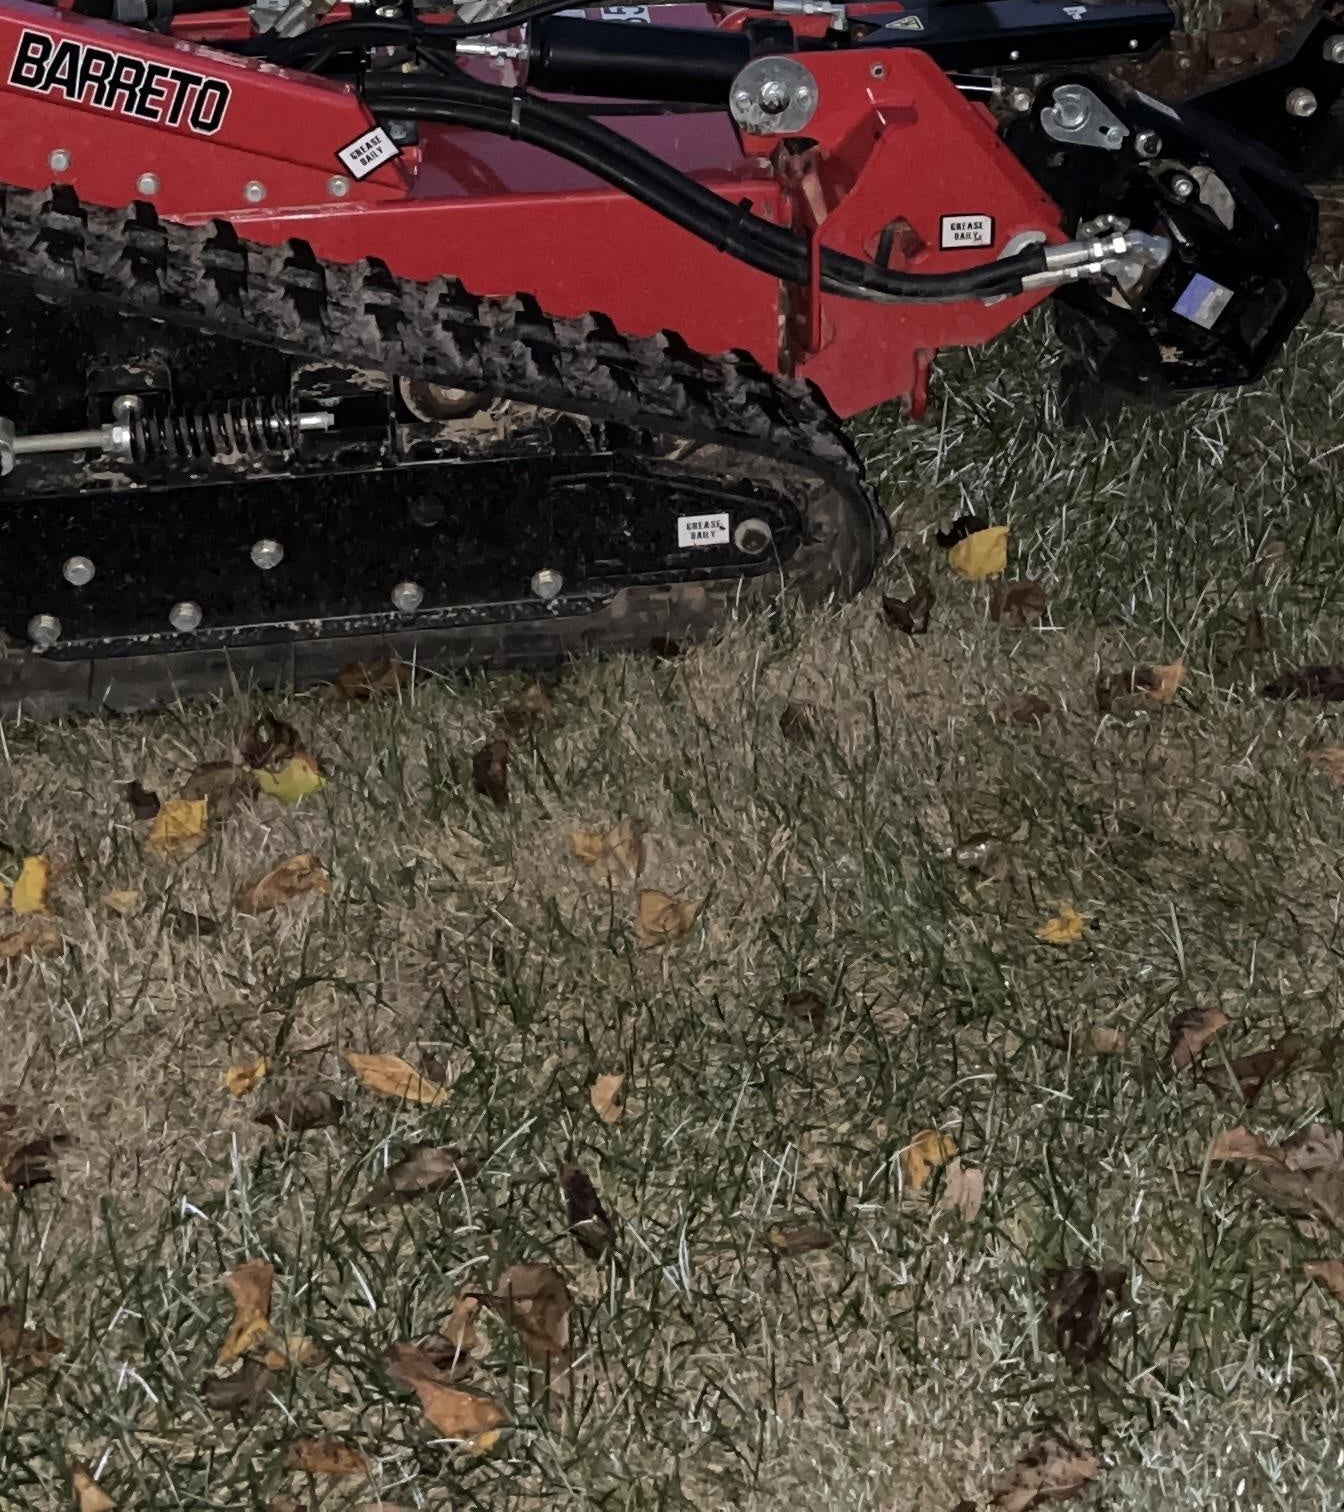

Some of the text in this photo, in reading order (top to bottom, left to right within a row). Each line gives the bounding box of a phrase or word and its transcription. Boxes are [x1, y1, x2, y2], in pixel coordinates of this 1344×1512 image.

[7, 28, 233, 136] BARRETO
[349, 135, 382, 160] GREASE
[359, 145, 384, 166] DAILY
[950, 221, 983, 231] GREASE
[954, 231, 981, 241] DAILY
[686, 520, 721, 530] GREASE
